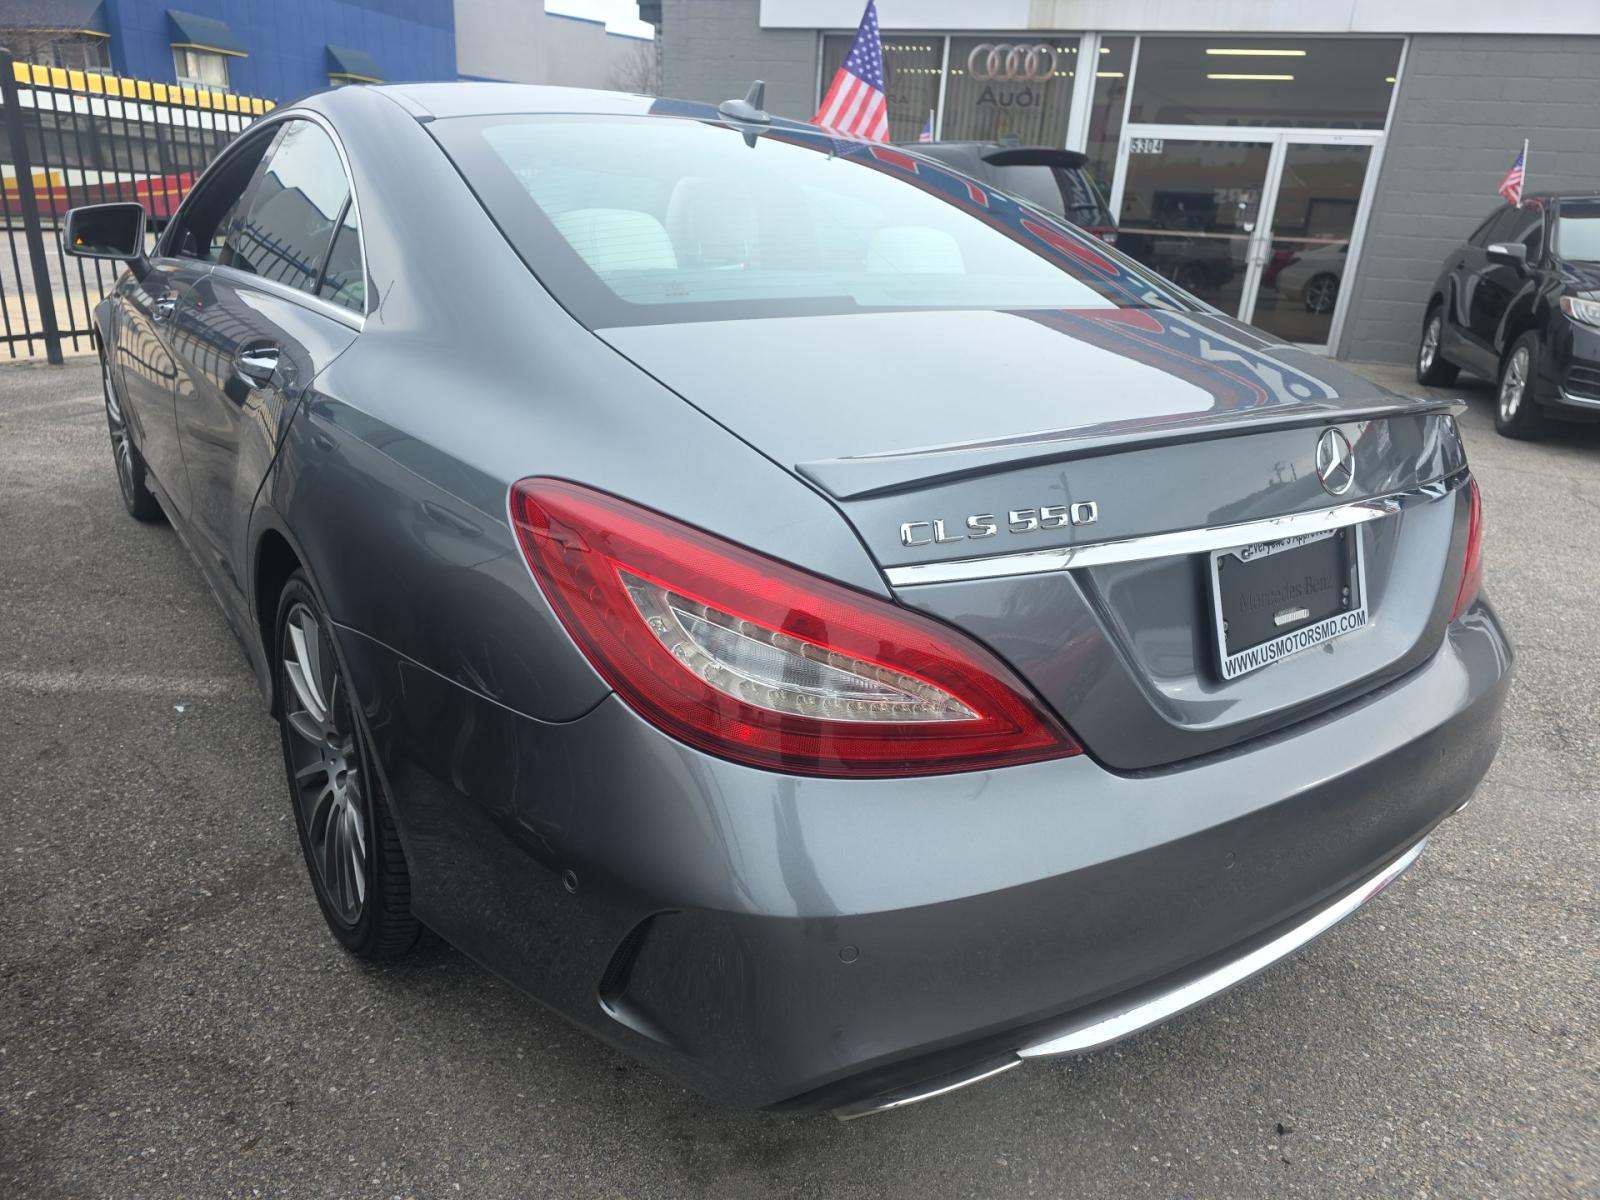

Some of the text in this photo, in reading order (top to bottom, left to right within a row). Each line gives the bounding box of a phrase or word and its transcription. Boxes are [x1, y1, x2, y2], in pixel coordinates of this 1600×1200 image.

[976, 86, 1040, 108] Audi
[900, 500, 1099, 547] CLS 550
[1225, 610, 1367, 677] WWW.USMOTORSMD.COM
